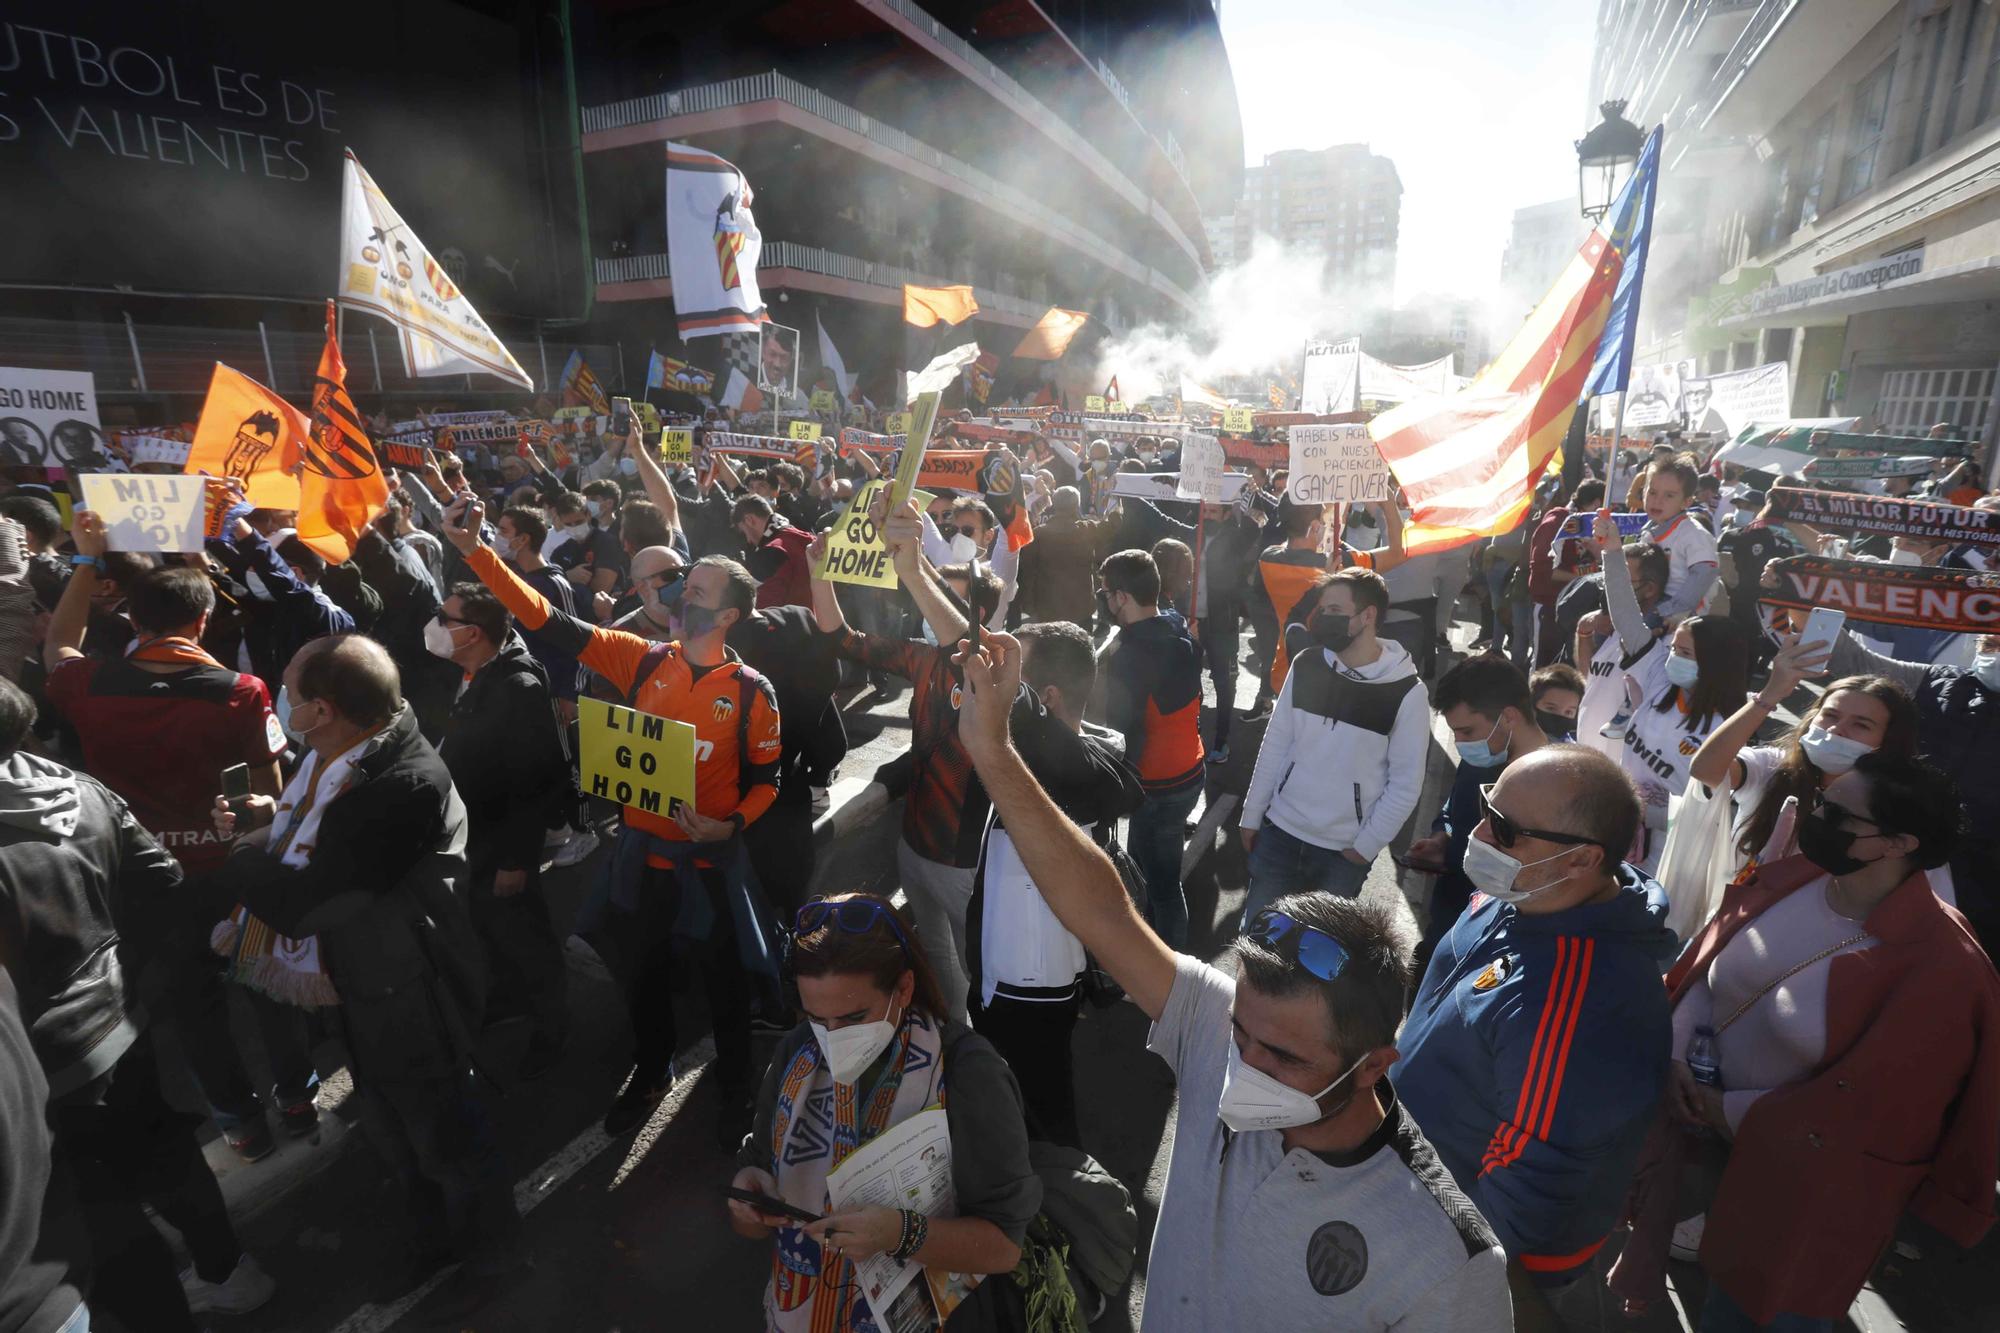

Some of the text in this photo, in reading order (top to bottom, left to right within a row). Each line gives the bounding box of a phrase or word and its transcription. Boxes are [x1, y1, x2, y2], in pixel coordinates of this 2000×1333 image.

[213, 65, 268, 117] ES
[281, 80, 342, 133] DE
[34, 96, 310, 182] VALIENTES
[1839, 254, 1921, 289] Concepción
[31, 390, 87, 411] HOME
[452, 425, 516, 443] VALENCIA
[667, 432, 685, 443] LIM
[796, 424, 811, 432] LIM
[1295, 429, 1340, 444] HABEIS
[661, 451, 692, 461] HOME
[670, 443, 680, 451] GO
[1303, 446, 1327, 457] CON
[1324, 458, 1382, 471] PACIENCIA
[1295, 471, 1386, 502] GAME OVER
[1803, 497, 1990, 528] EL MILLOR FUTUR
[1806, 513, 1818, 522] AL
[1820, 515, 1855, 527] MILLOR
[1909, 525, 1923, 535] DE
[1926, 527, 1942, 537] LA
[846, 517, 877, 544] GO
[825, 547, 888, 578] HOME
[1788, 572, 2000, 622] VALENC
[606, 706, 664, 741] LIM
[615, 745, 657, 775] GO
[1624, 723, 1675, 780] bwin
